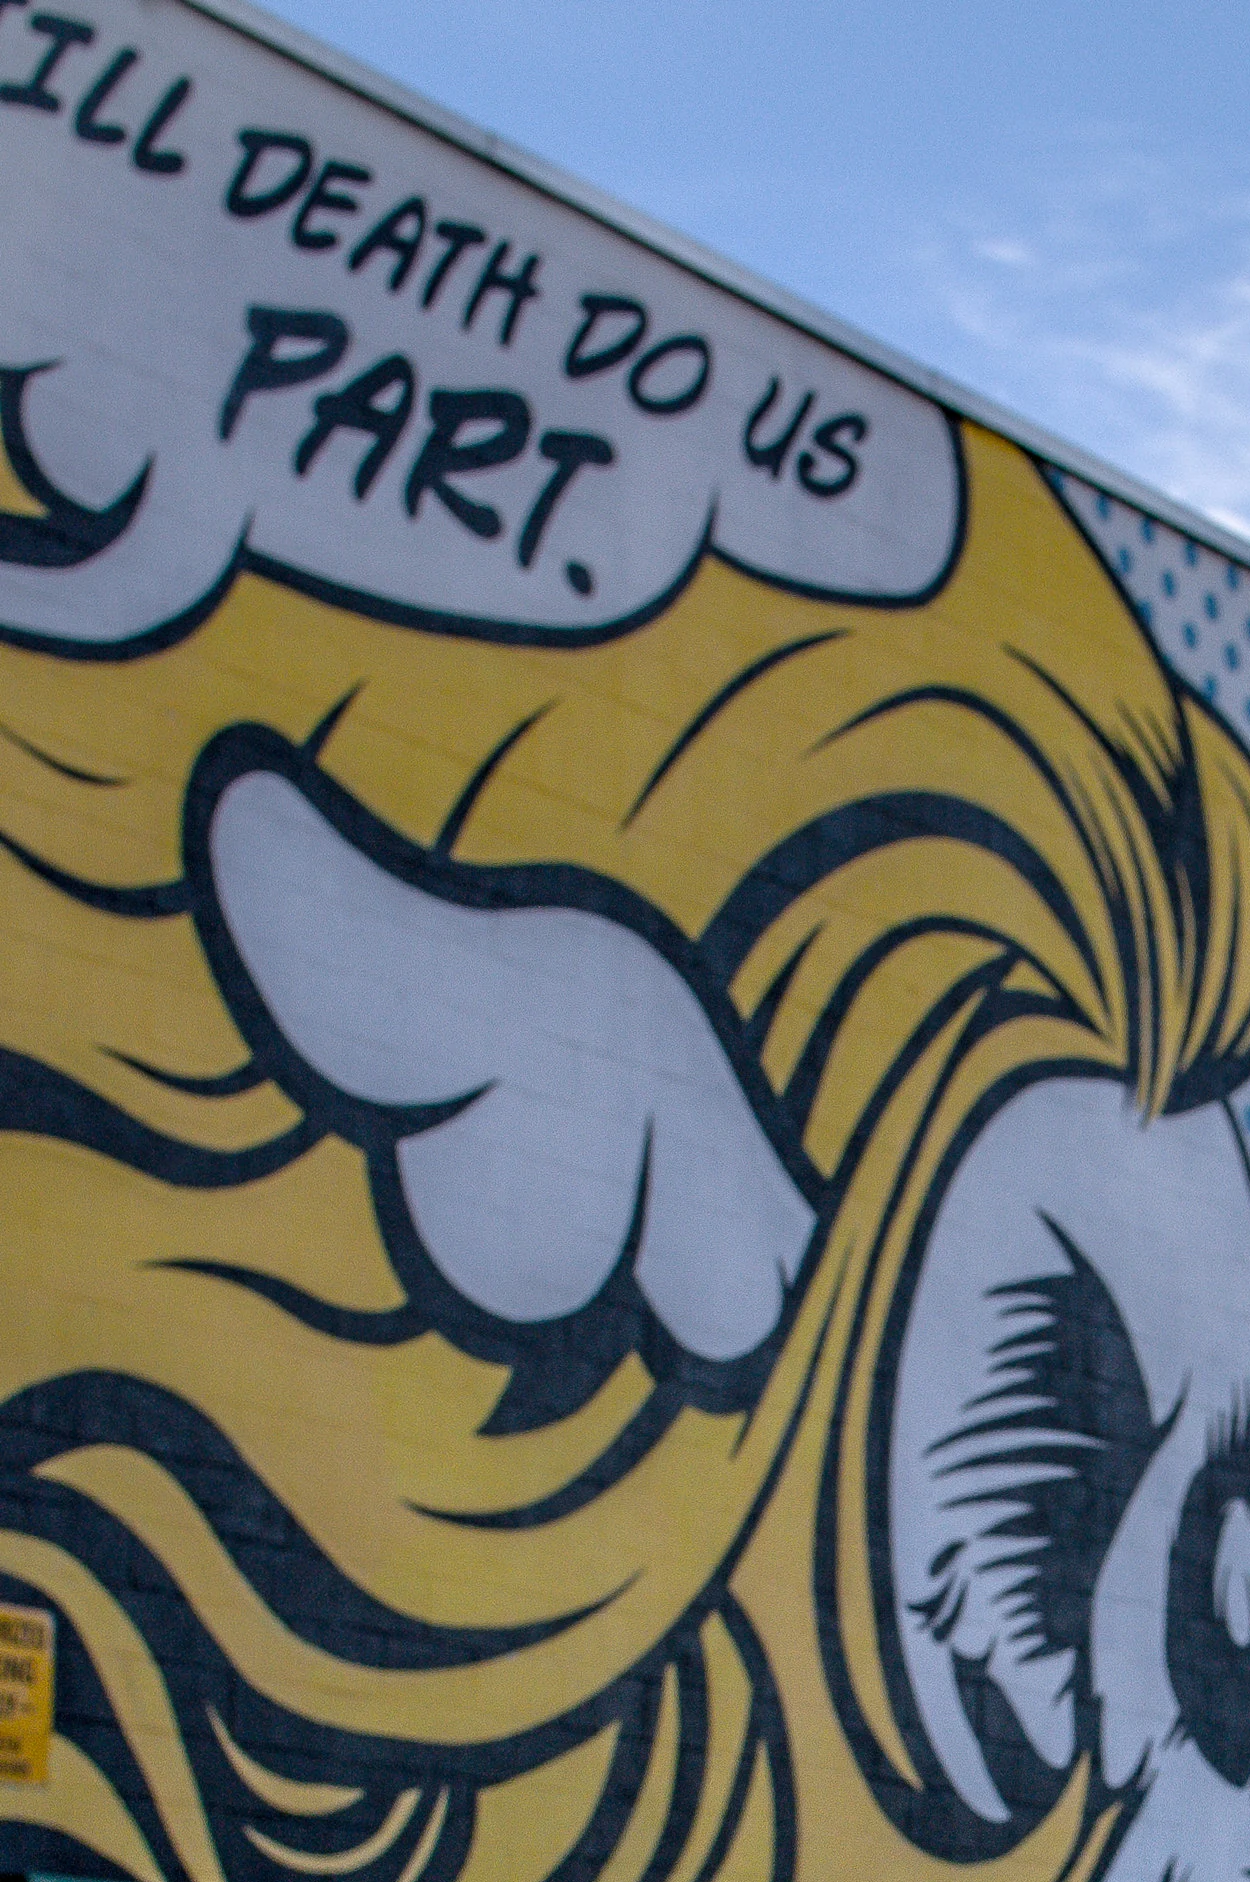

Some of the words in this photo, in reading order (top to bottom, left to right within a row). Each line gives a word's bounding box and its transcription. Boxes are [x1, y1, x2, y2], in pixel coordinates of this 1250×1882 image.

[0, 0, 192, 176] ILL
[222, 129, 541, 347] DEATH
[563, 294, 712, 415] DO
[743, 376, 868, 497] US
[218, 305, 616, 596] PART.
